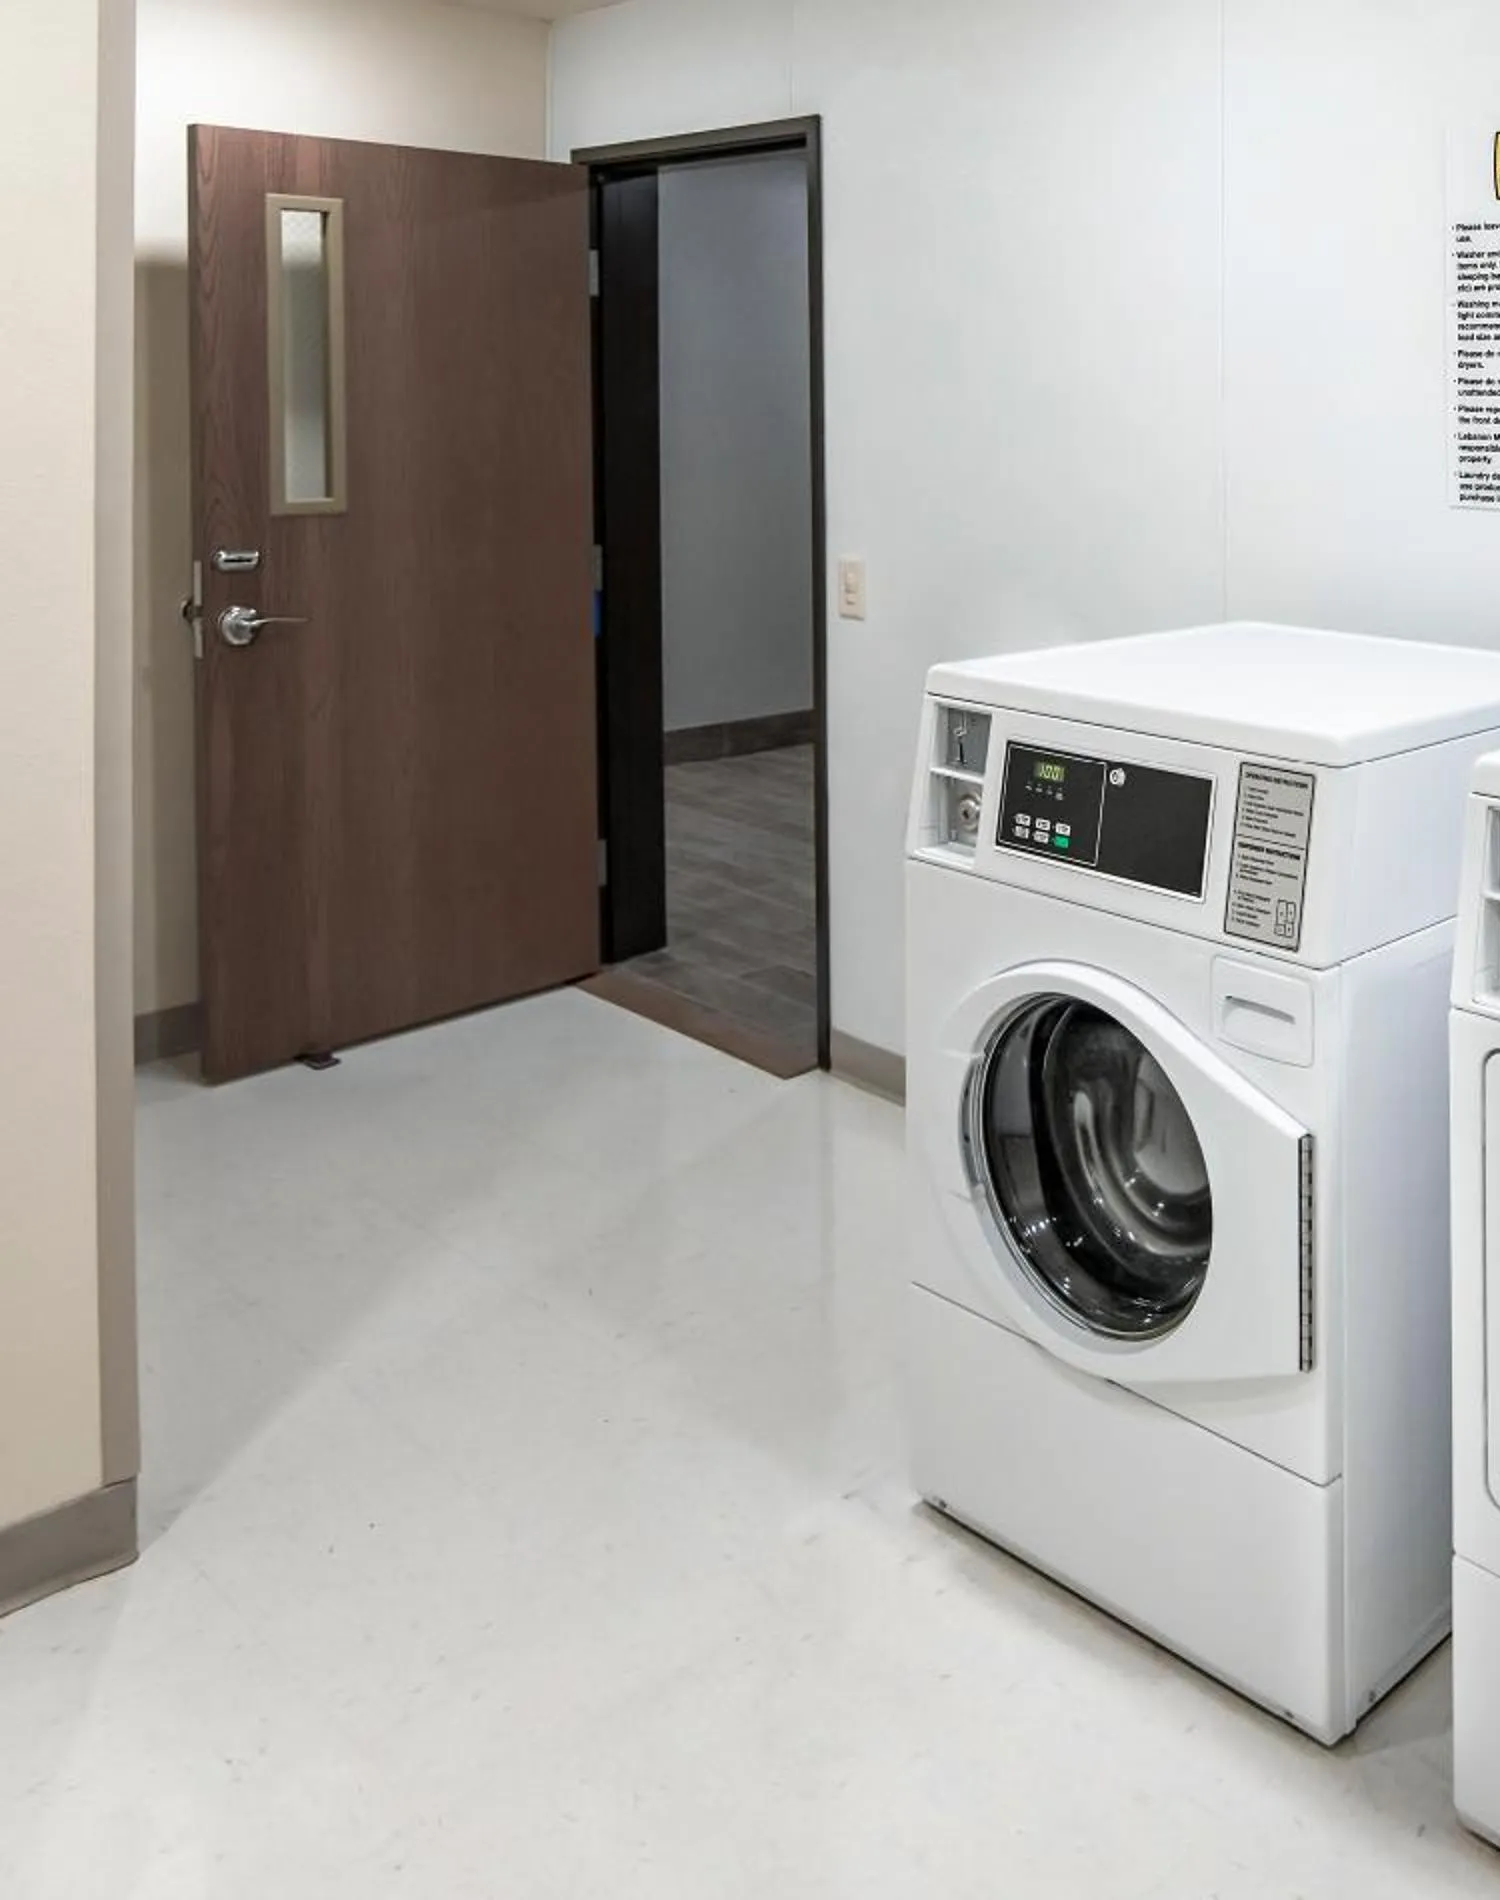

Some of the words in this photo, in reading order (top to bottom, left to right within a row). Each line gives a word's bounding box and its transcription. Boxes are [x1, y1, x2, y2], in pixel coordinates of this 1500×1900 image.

[1455, 223, 1481, 231] Please
[1455, 250, 1485, 259] Washer
[1457, 299, 1490, 310] Washing
[1457, 349, 1482, 358] Please
[1484, 349, 1494, 358] do
[1457, 377, 1483, 385] Please
[1485, 377, 1495, 385] do
[1457, 405, 1484, 413] Please
[1458, 471, 1491, 482] Laundry
